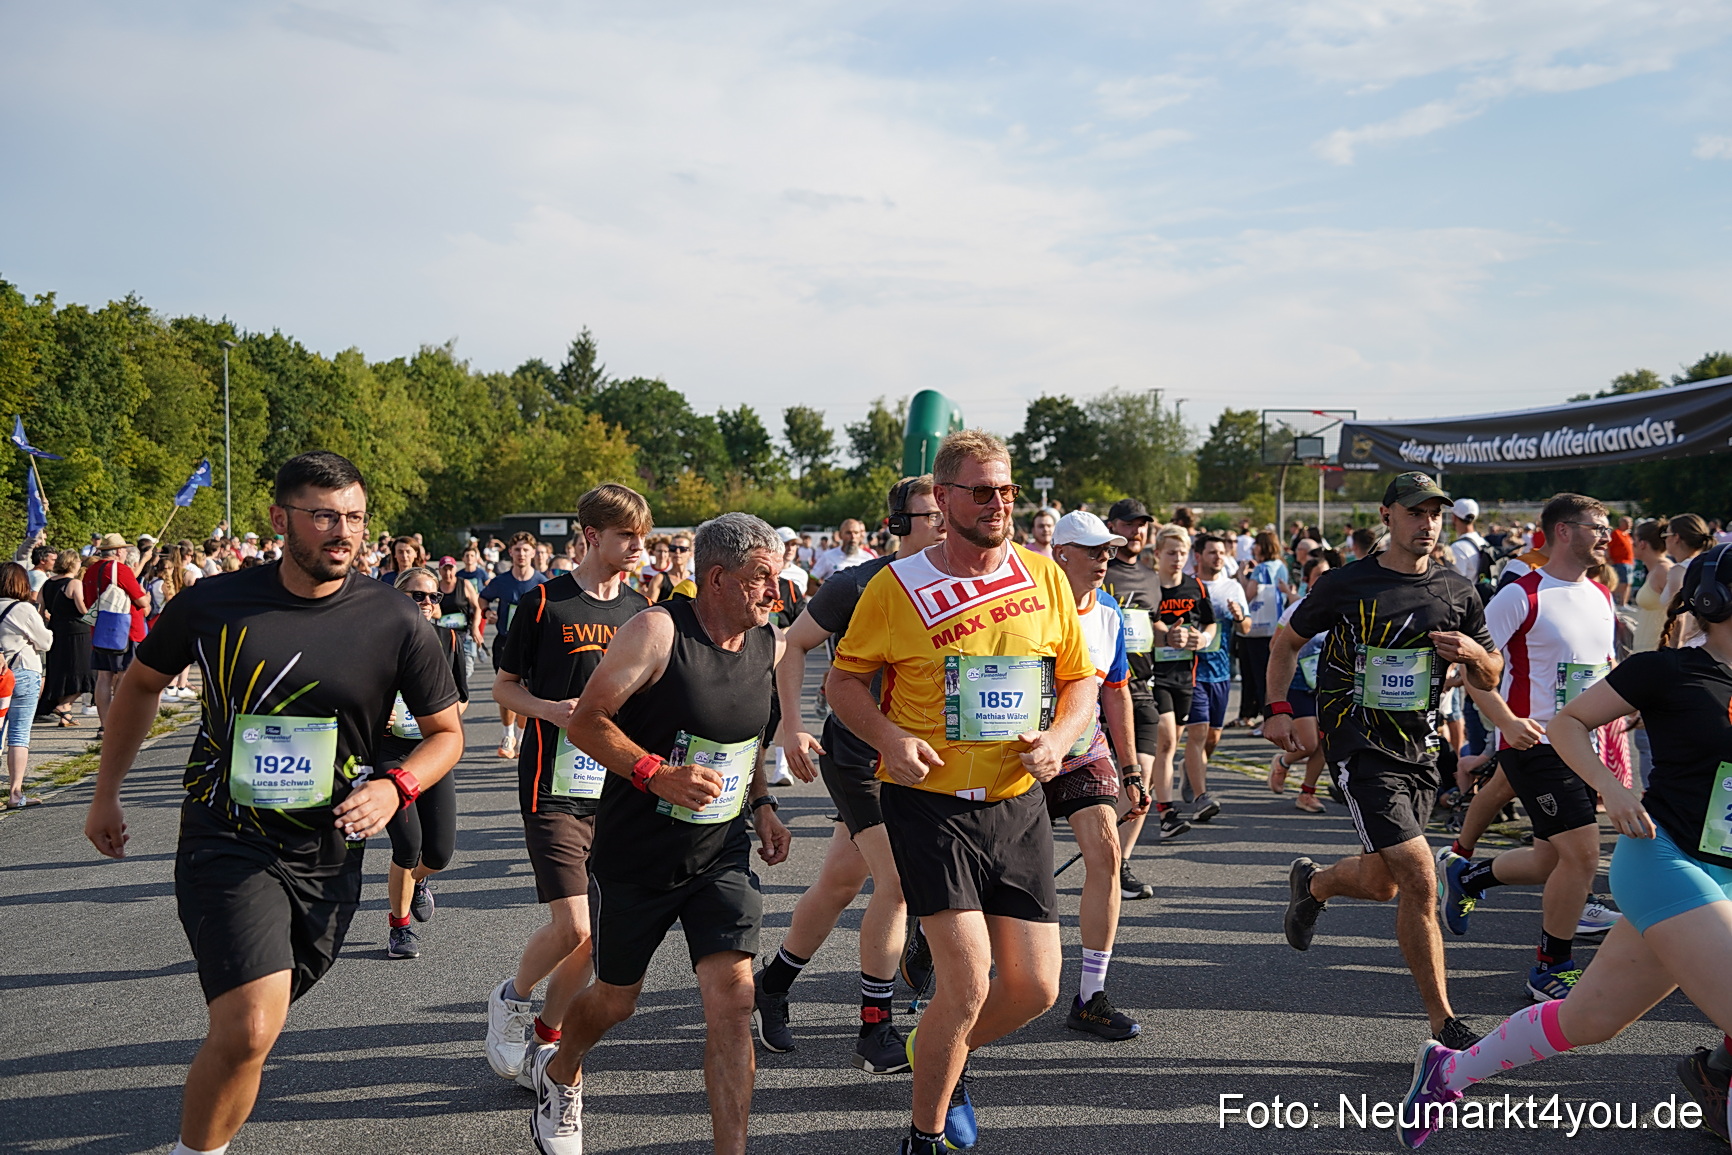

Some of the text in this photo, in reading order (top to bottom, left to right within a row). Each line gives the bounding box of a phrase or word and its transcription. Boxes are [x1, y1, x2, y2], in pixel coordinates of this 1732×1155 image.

[1399, 416, 1685, 470] Hier gewinnt das Miteinander.
[931, 595, 1046, 650] MAX BÖGL
[562, 624, 574, 643] BIT
[1381, 675, 1414, 688] 1916
[979, 691, 1024, 708] 1857
[976, 712, 1029, 720] Mathias Wälzel
[254, 755, 311, 774] 1924
[252, 779, 314, 787] Lucas Schwab
[573, 773, 604, 782] Eric Horne
